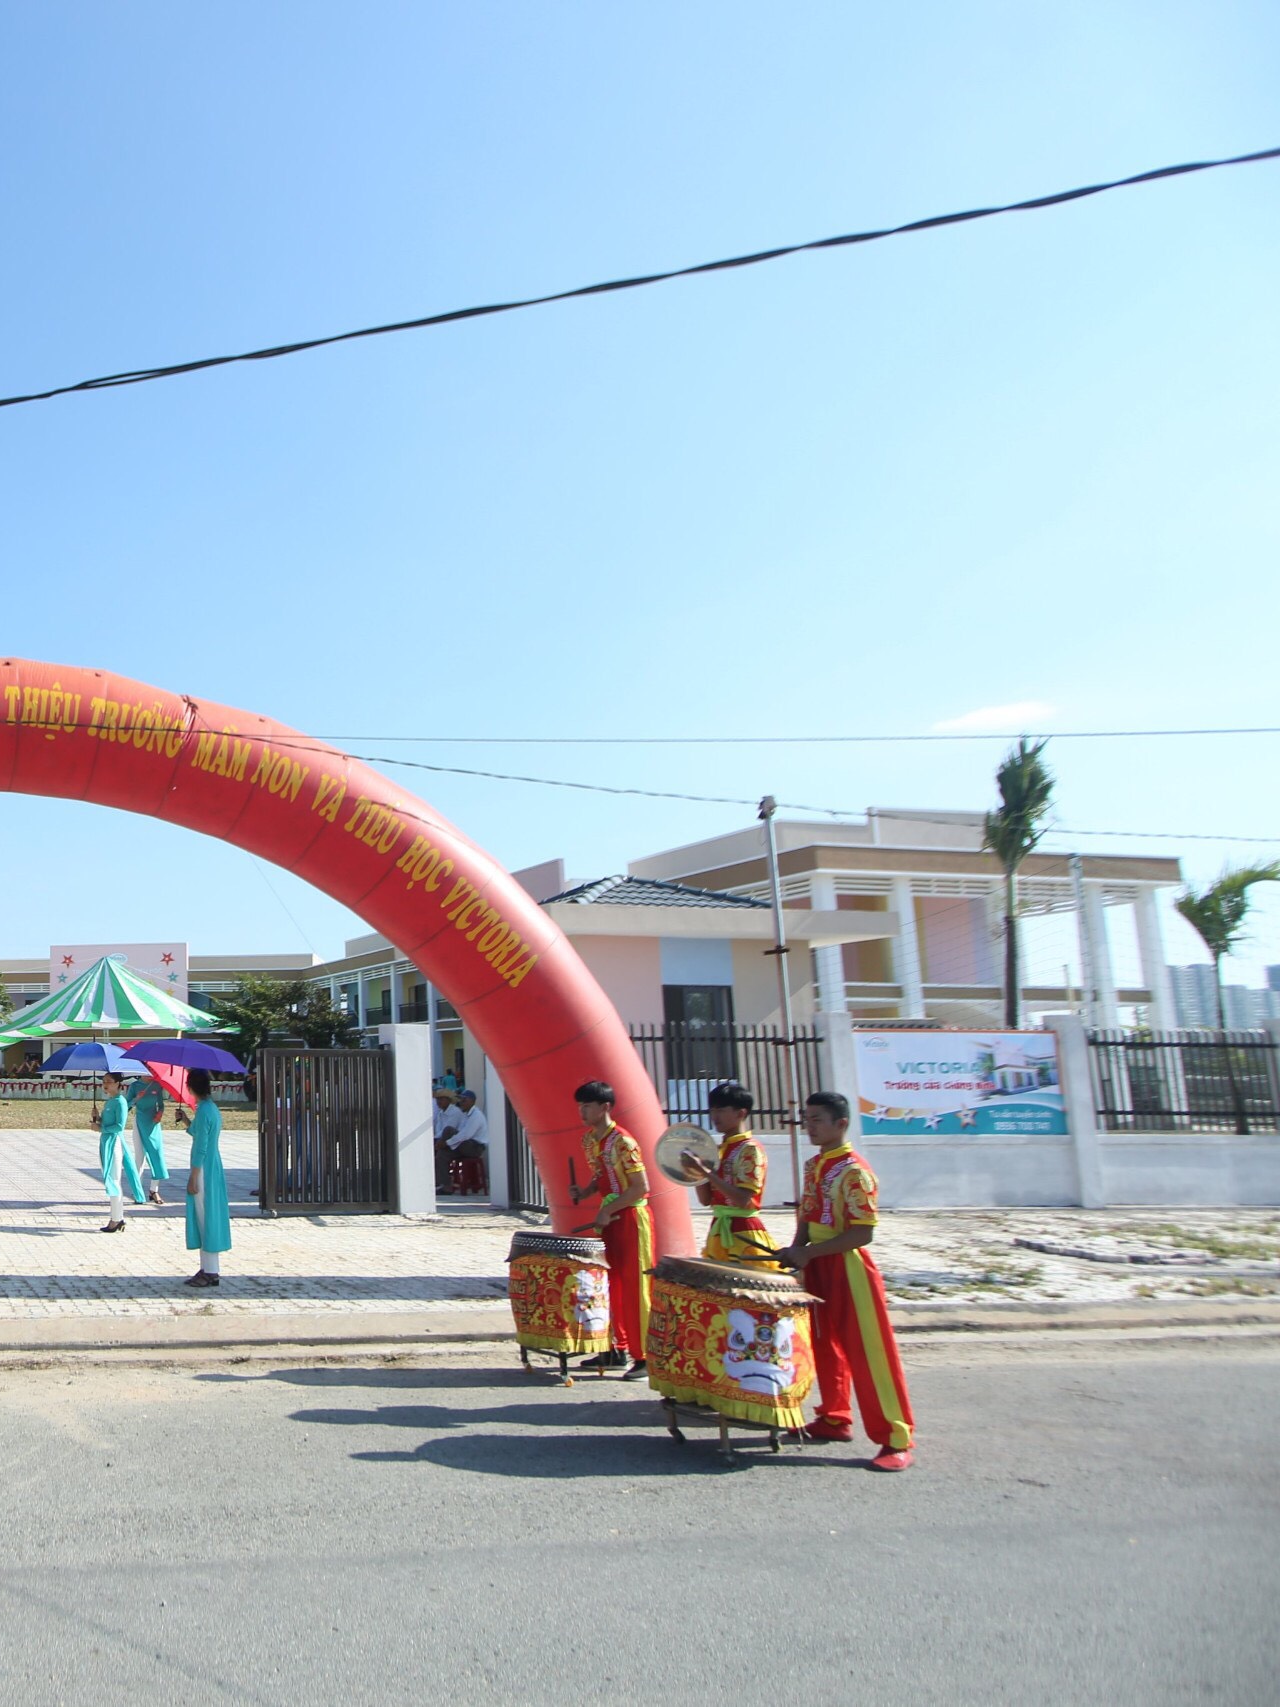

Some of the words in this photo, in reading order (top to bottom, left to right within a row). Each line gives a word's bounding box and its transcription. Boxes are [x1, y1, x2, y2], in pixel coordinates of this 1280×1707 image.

[4, 681, 82, 741] THIỆU
[87, 695, 187, 759] TRƯỜNG
[250, 746, 311, 804] NON
[310, 773, 348, 823] VÀ
[396, 834, 455, 893] HỌC
[440, 876, 540, 989] VICTORIA
[896, 1061, 982, 1075] VICTORIA
